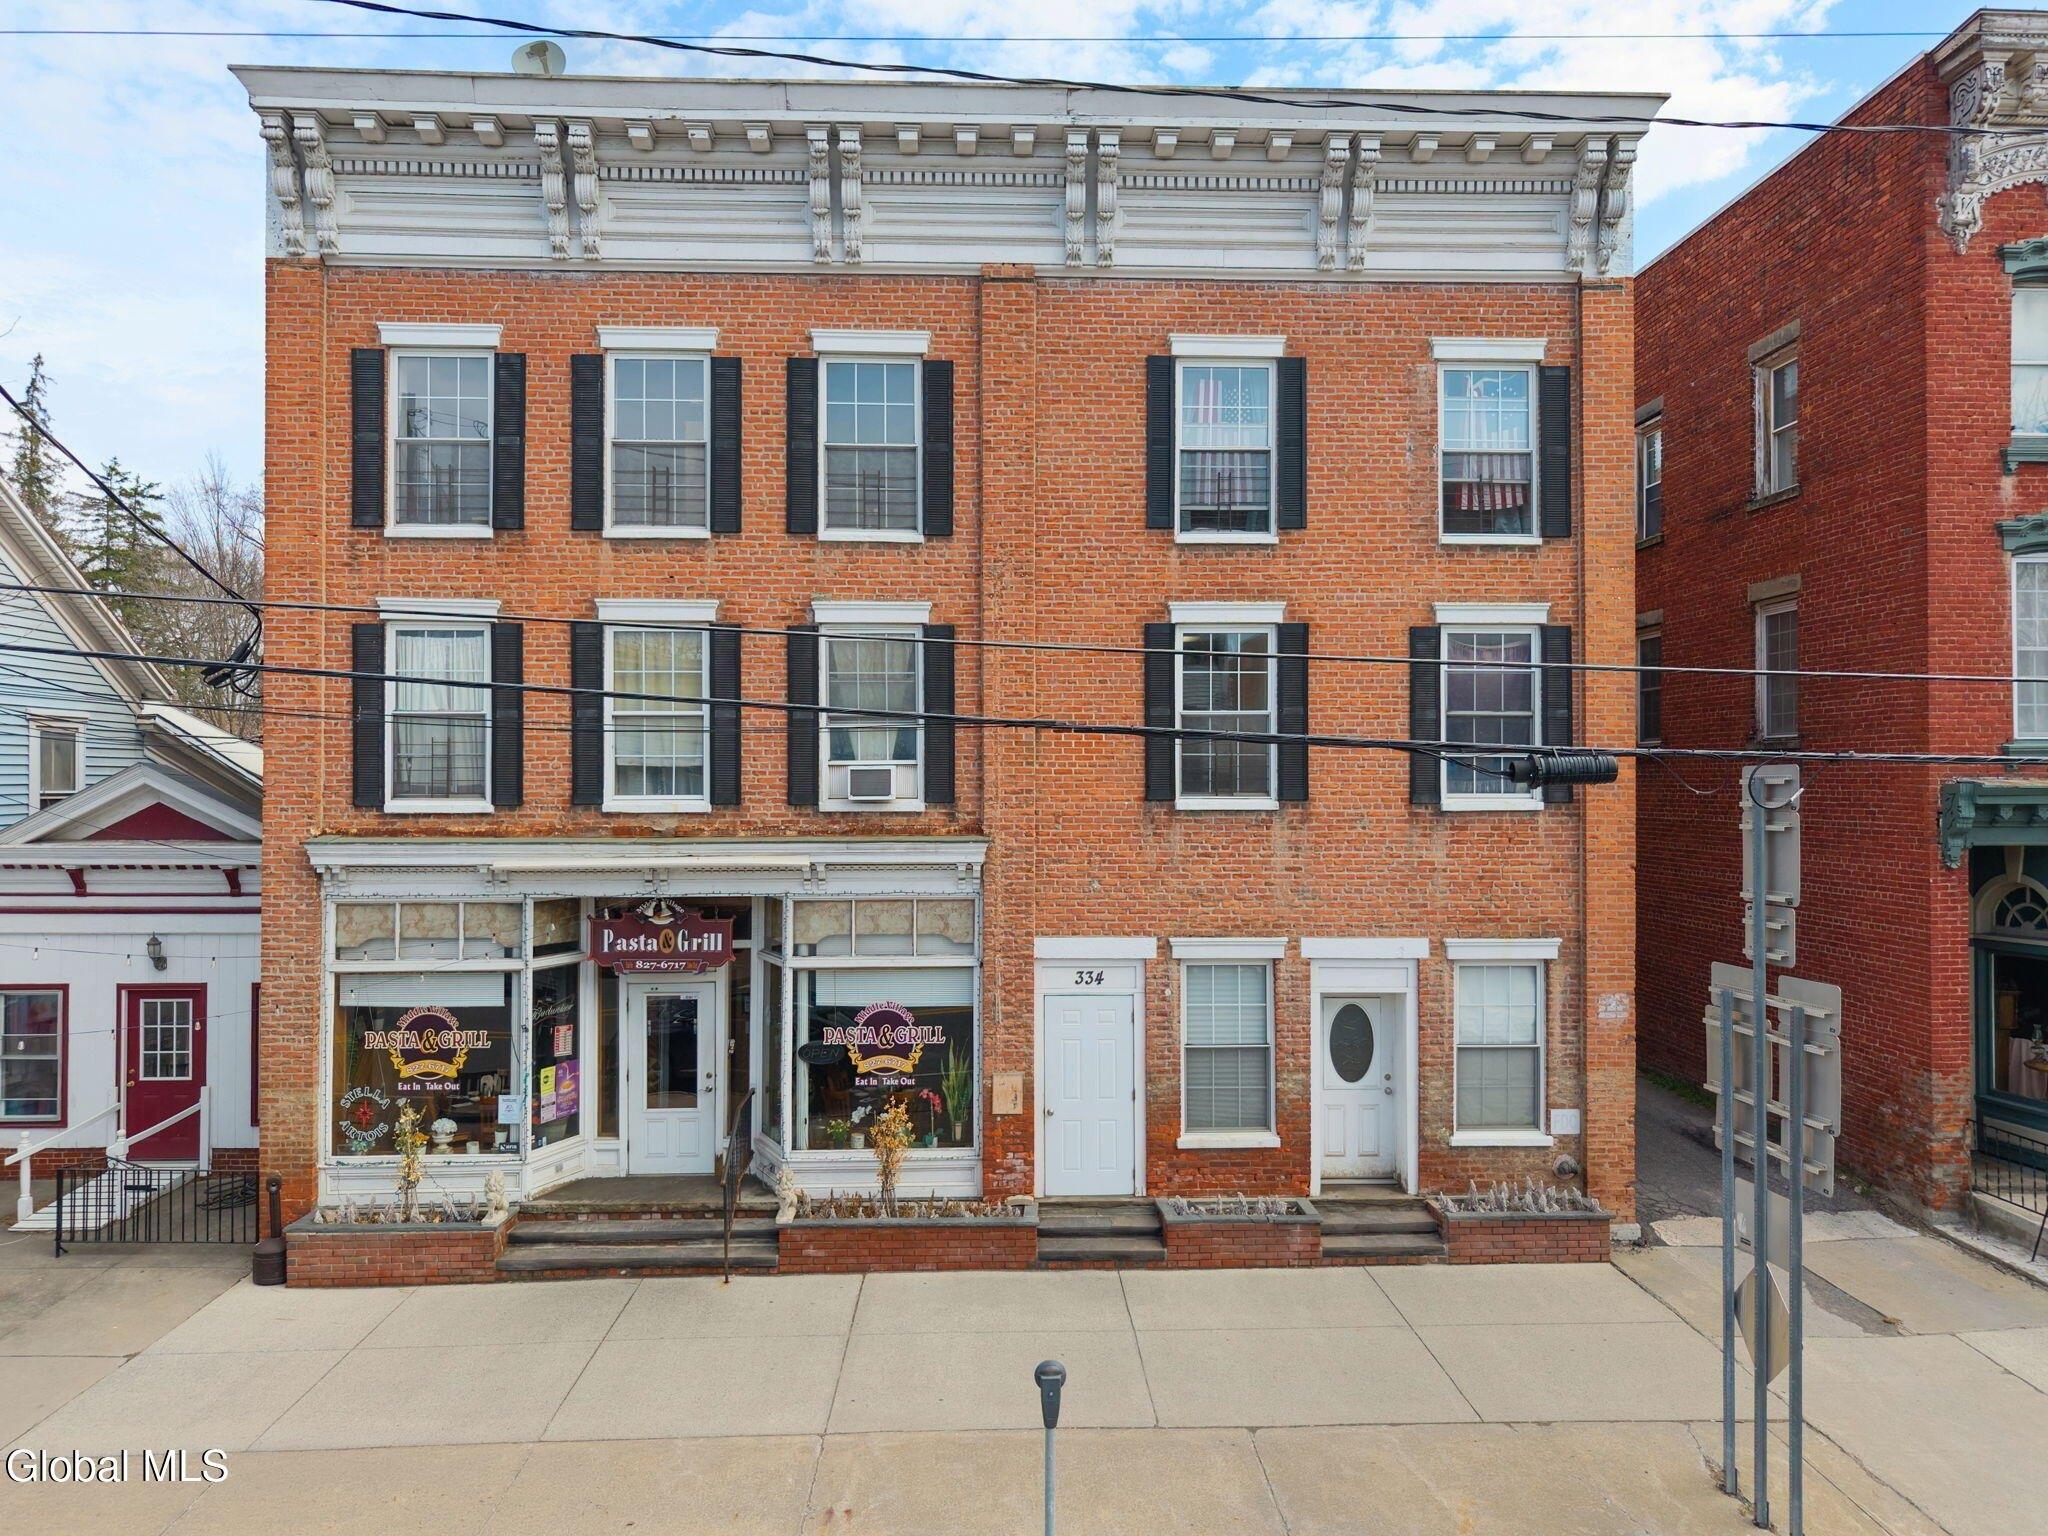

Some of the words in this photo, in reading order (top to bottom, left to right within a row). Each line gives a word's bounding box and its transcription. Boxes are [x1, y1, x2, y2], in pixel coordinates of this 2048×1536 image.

[602, 929, 657, 953] Pasta
[661, 932, 673, 951] &
[677, 929, 723, 953] Grill
[635, 960, 687, 969] 827-6717
[1075, 970, 1104, 985] 334
[396, 1006, 428, 1027] Middle
[429, 1005, 459, 1027] Village
[853, 1002, 885, 1023] Middle
[886, 1001, 915, 1023] Village
[364, 1030, 421, 1049] PASTA
[420, 1028, 438, 1054] &
[438, 1030, 491, 1049] GRILL
[823, 1026, 877, 1045] PASTA
[877, 1024, 895, 1049] &
[894, 1026, 946, 1045] GRILL
[398, 1082, 411, 1091] Eat
[412, 1082, 421, 1091] In
[425, 1082, 443, 1091] Take
[444, 1082, 460, 1091] Out
[855, 1077, 868, 1086] Eat
[869, 1077, 878, 1086] In
[882, 1077, 899, 1086] Take
[900, 1077, 915, 1086] Out
[340, 1086, 391, 1110] STELLA
[338, 1120, 389, 1142] ARTOIS
